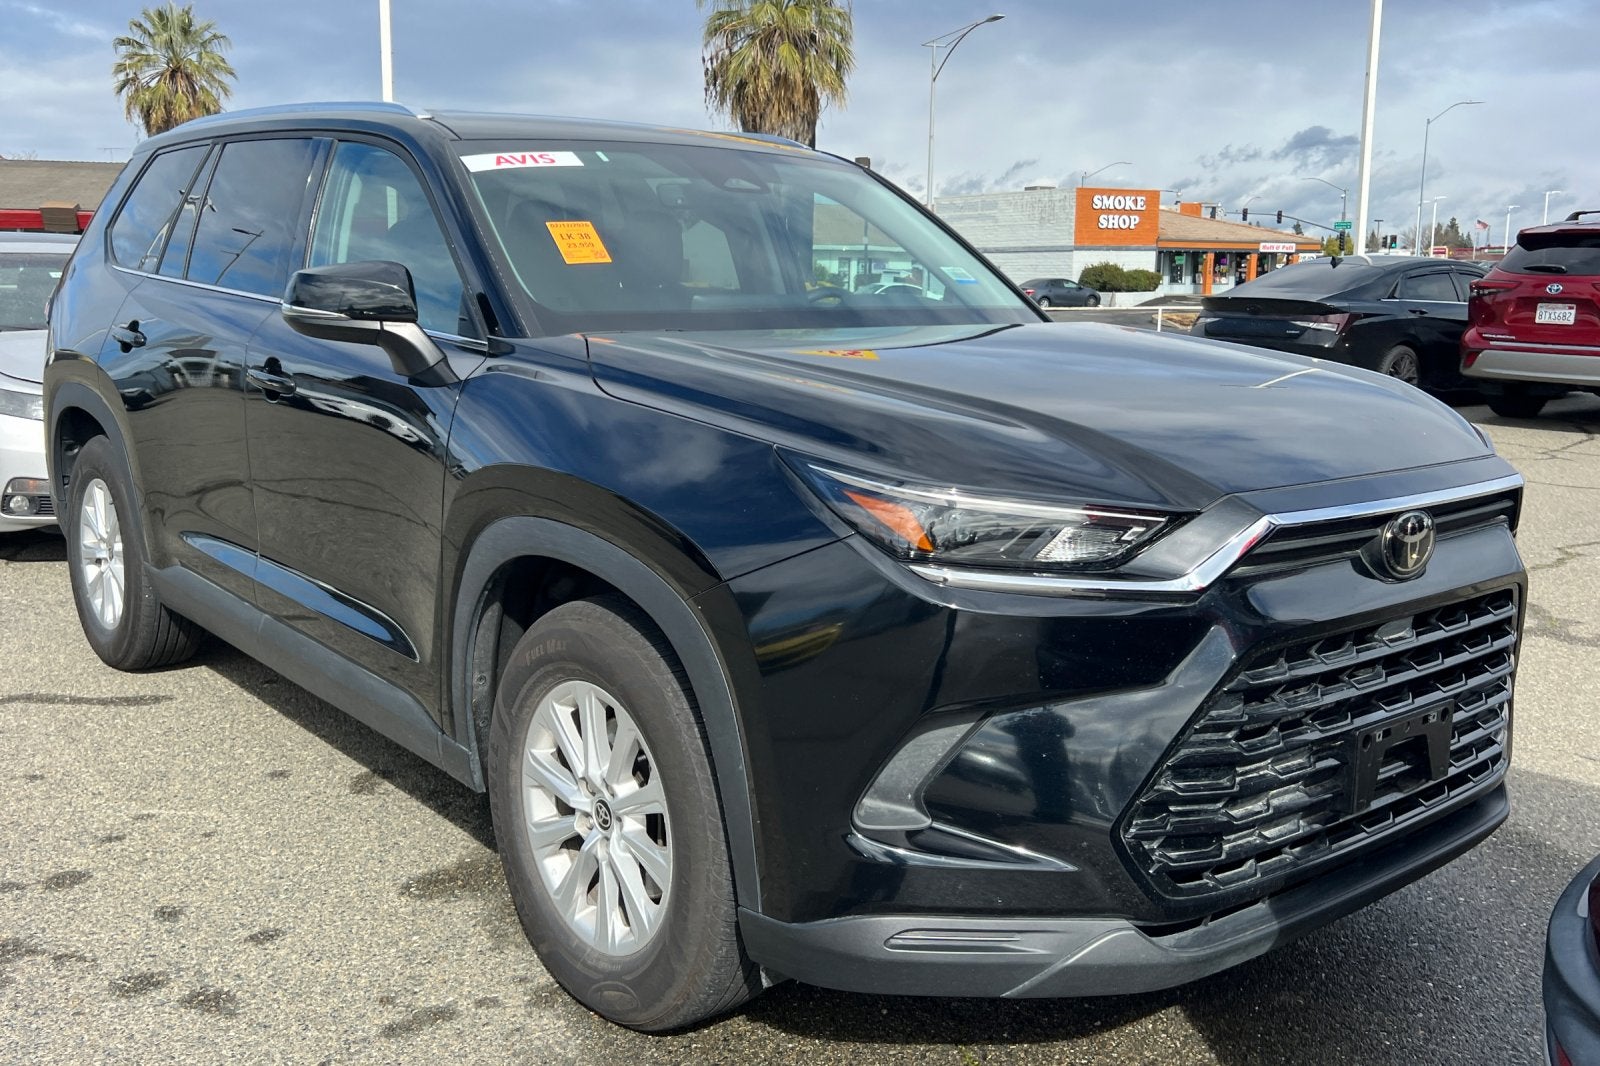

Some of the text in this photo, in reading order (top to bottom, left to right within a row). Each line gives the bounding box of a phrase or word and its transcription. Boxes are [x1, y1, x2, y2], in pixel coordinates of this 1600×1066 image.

[495, 154, 556, 166] AVIS
[1092, 194, 1146, 211] SMOKE
[1098, 214, 1140, 230] SHOP
